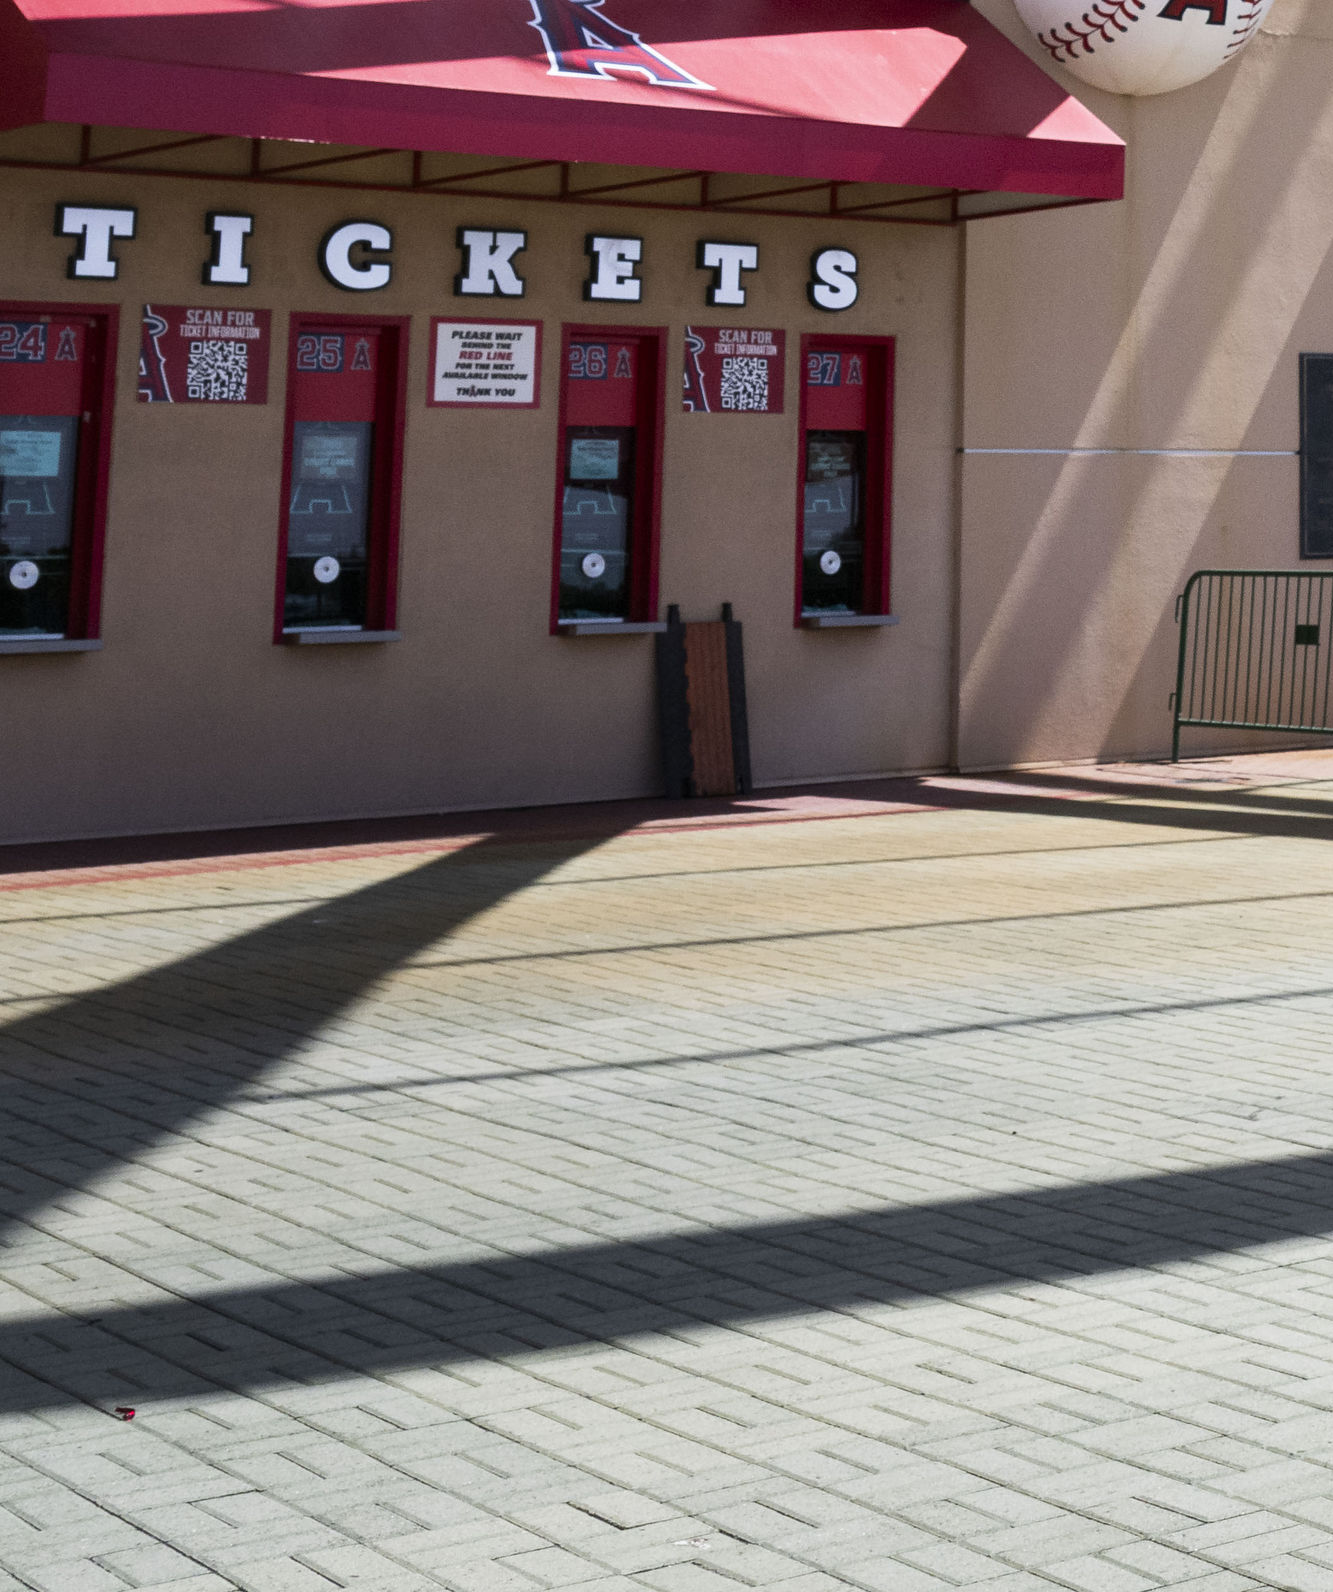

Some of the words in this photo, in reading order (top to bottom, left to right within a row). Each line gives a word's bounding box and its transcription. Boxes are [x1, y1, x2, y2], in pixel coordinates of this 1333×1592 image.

[55, 204, 861, 312] TICKETS
[186, 309, 223, 325] SCAN
[226, 311, 255, 326] FOR
[180, 324, 207, 337] TICKET
[208, 326, 260, 339] INFORMATION
[451, 330, 493, 340] PLEASE
[495, 331, 523, 341] WAIT
[719, 329, 748, 343] SCAN
[751, 330, 773, 344] FOR
[297, 335, 343, 370] 25
[461, 341, 494, 349] BEHIND
[496, 342, 512, 350] THE
[459, 351, 483, 360] RED
[486, 351, 513, 361] LINE
[568, 343, 607, 378] 26
[493, 363, 515, 371] NEXT
[807, 352, 840, 385] 27
[456, 385, 491, 397] THANK
[495, 389, 516, 397] YOU
